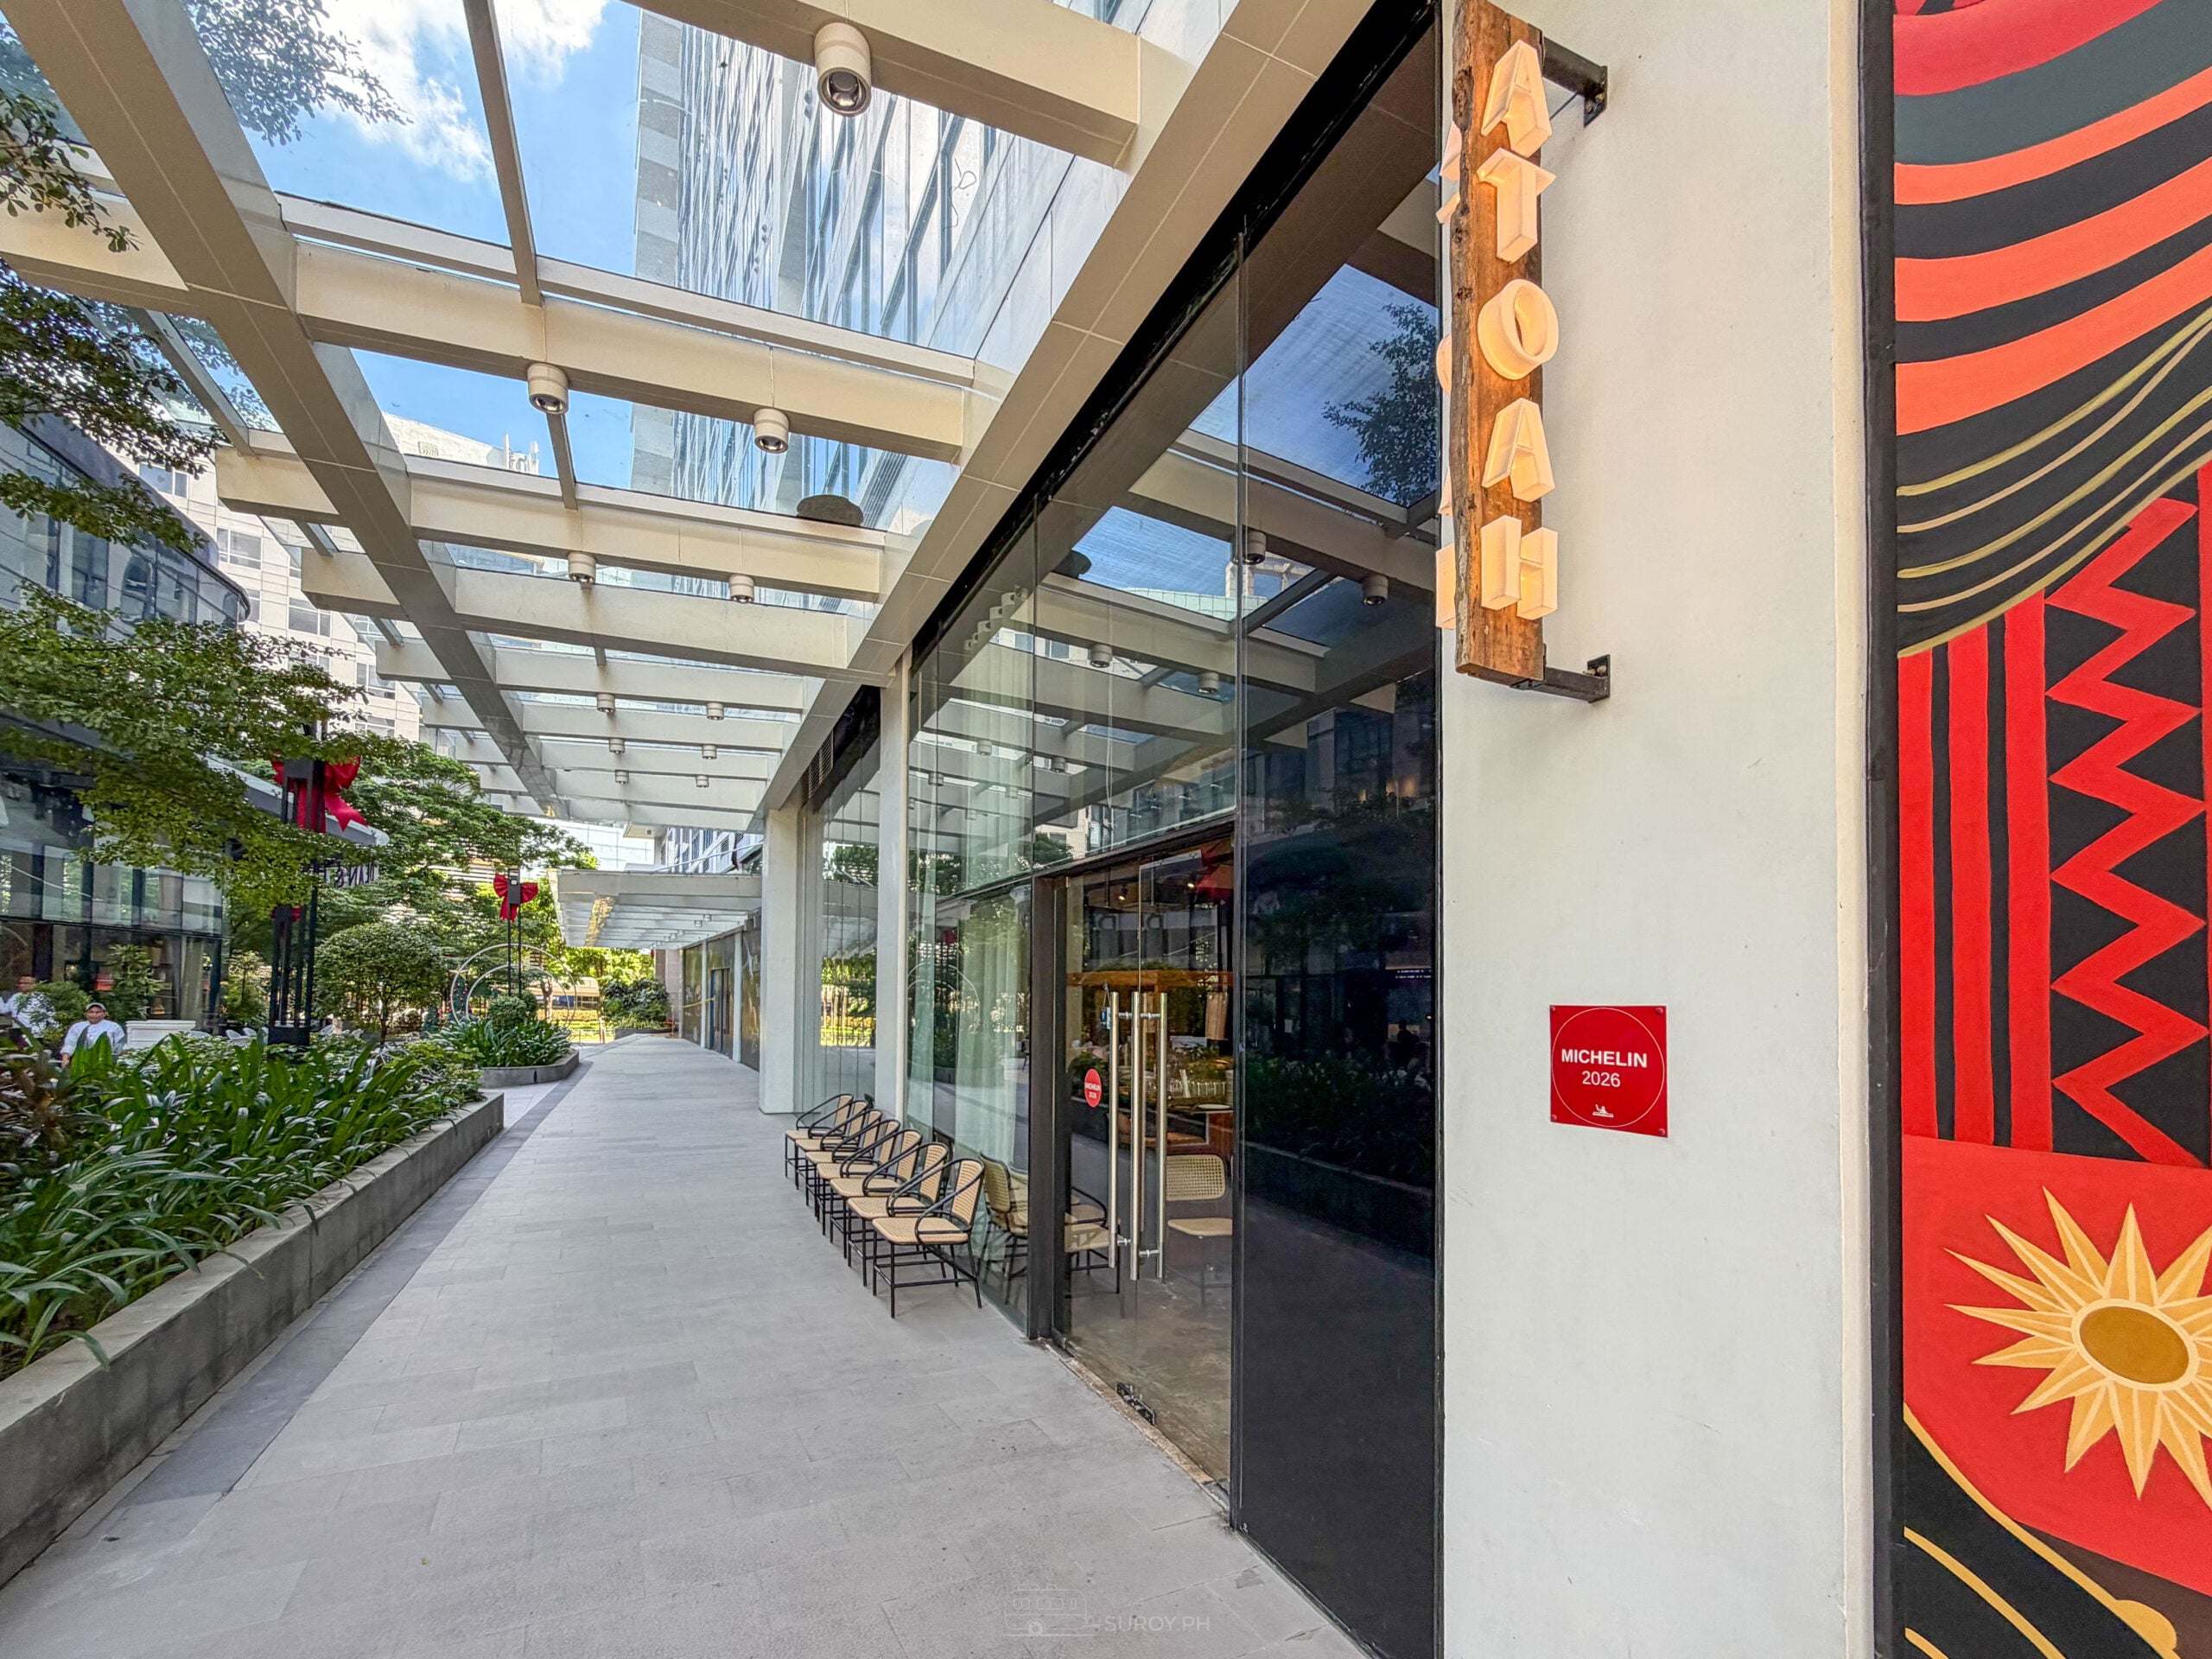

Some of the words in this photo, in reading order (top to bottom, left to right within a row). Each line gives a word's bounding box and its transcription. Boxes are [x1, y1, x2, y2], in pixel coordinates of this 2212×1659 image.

[1477, 39, 1559, 620] ATOAH
[1561, 1048, 1648, 1068] MICHELIN
[1582, 1071, 1621, 1088] 2026
